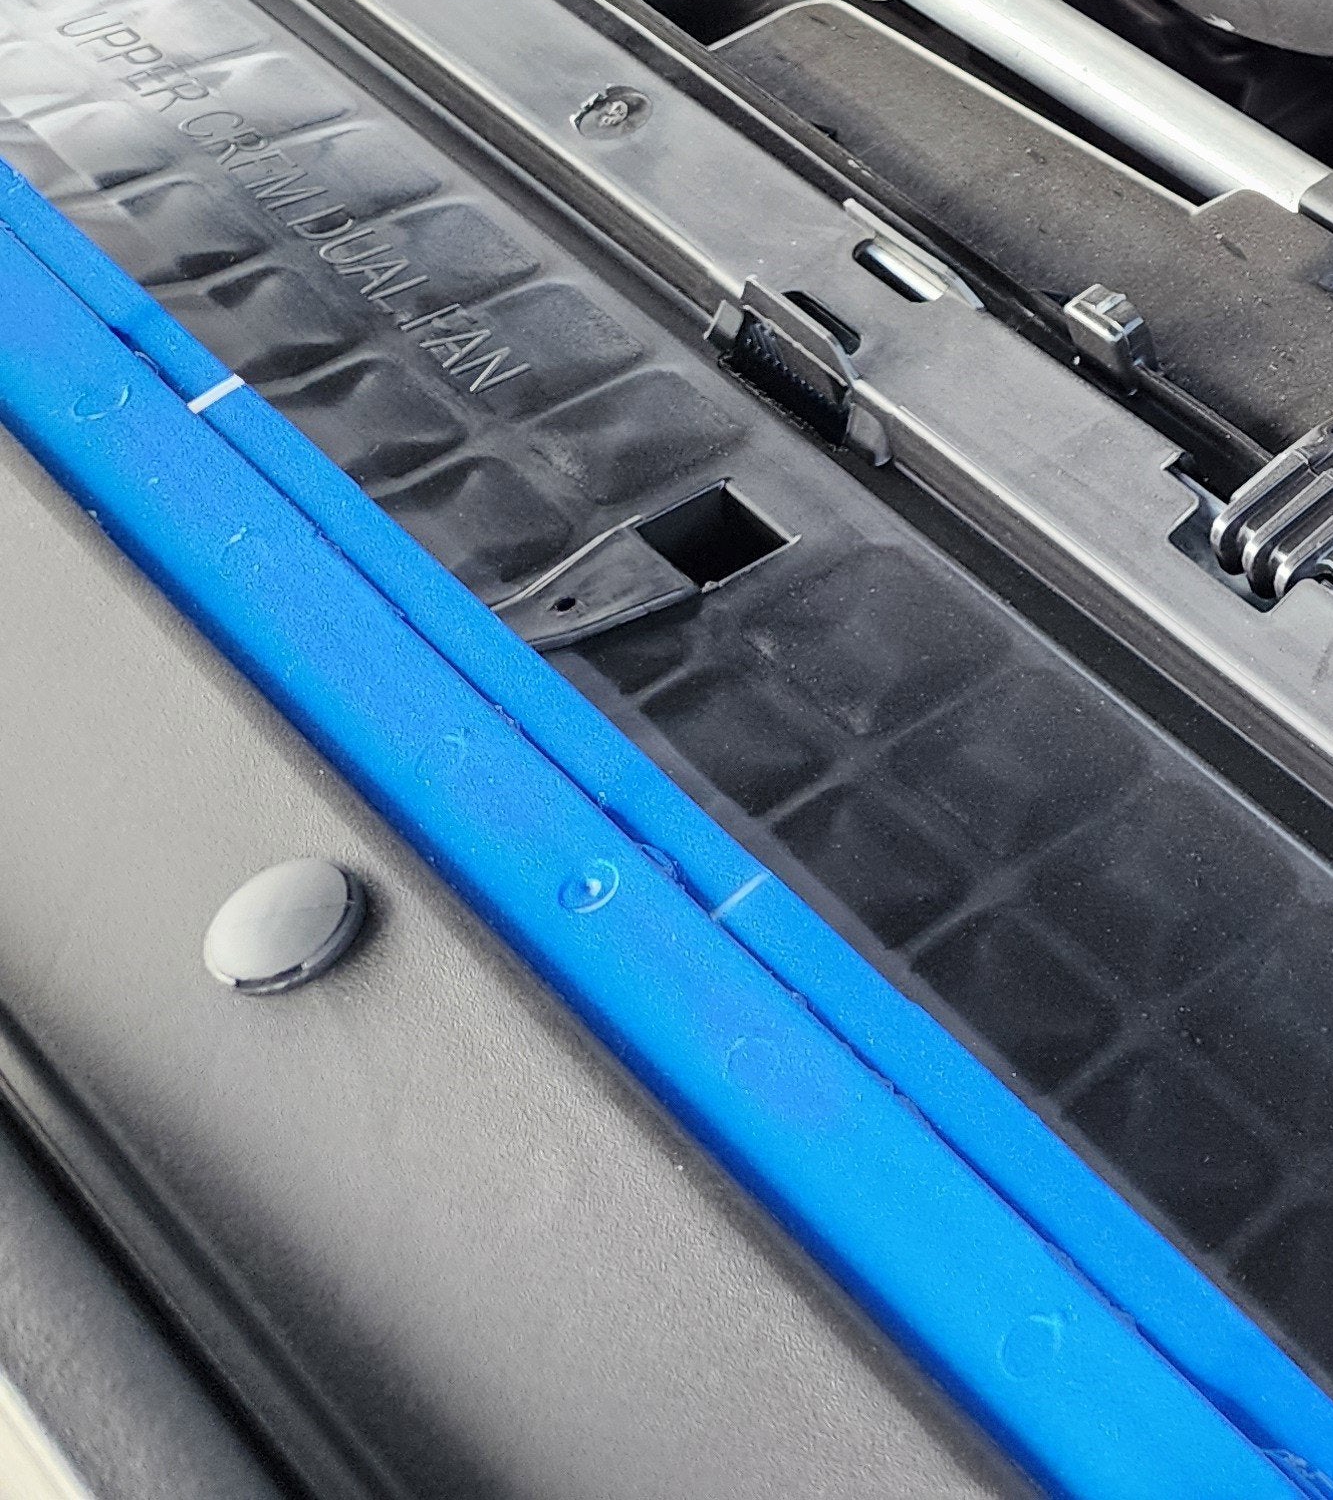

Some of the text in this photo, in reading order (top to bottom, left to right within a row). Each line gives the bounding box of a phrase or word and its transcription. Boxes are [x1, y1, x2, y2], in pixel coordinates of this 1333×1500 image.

[56, 12, 530, 395] UPPER CRFM DUAL FAN
